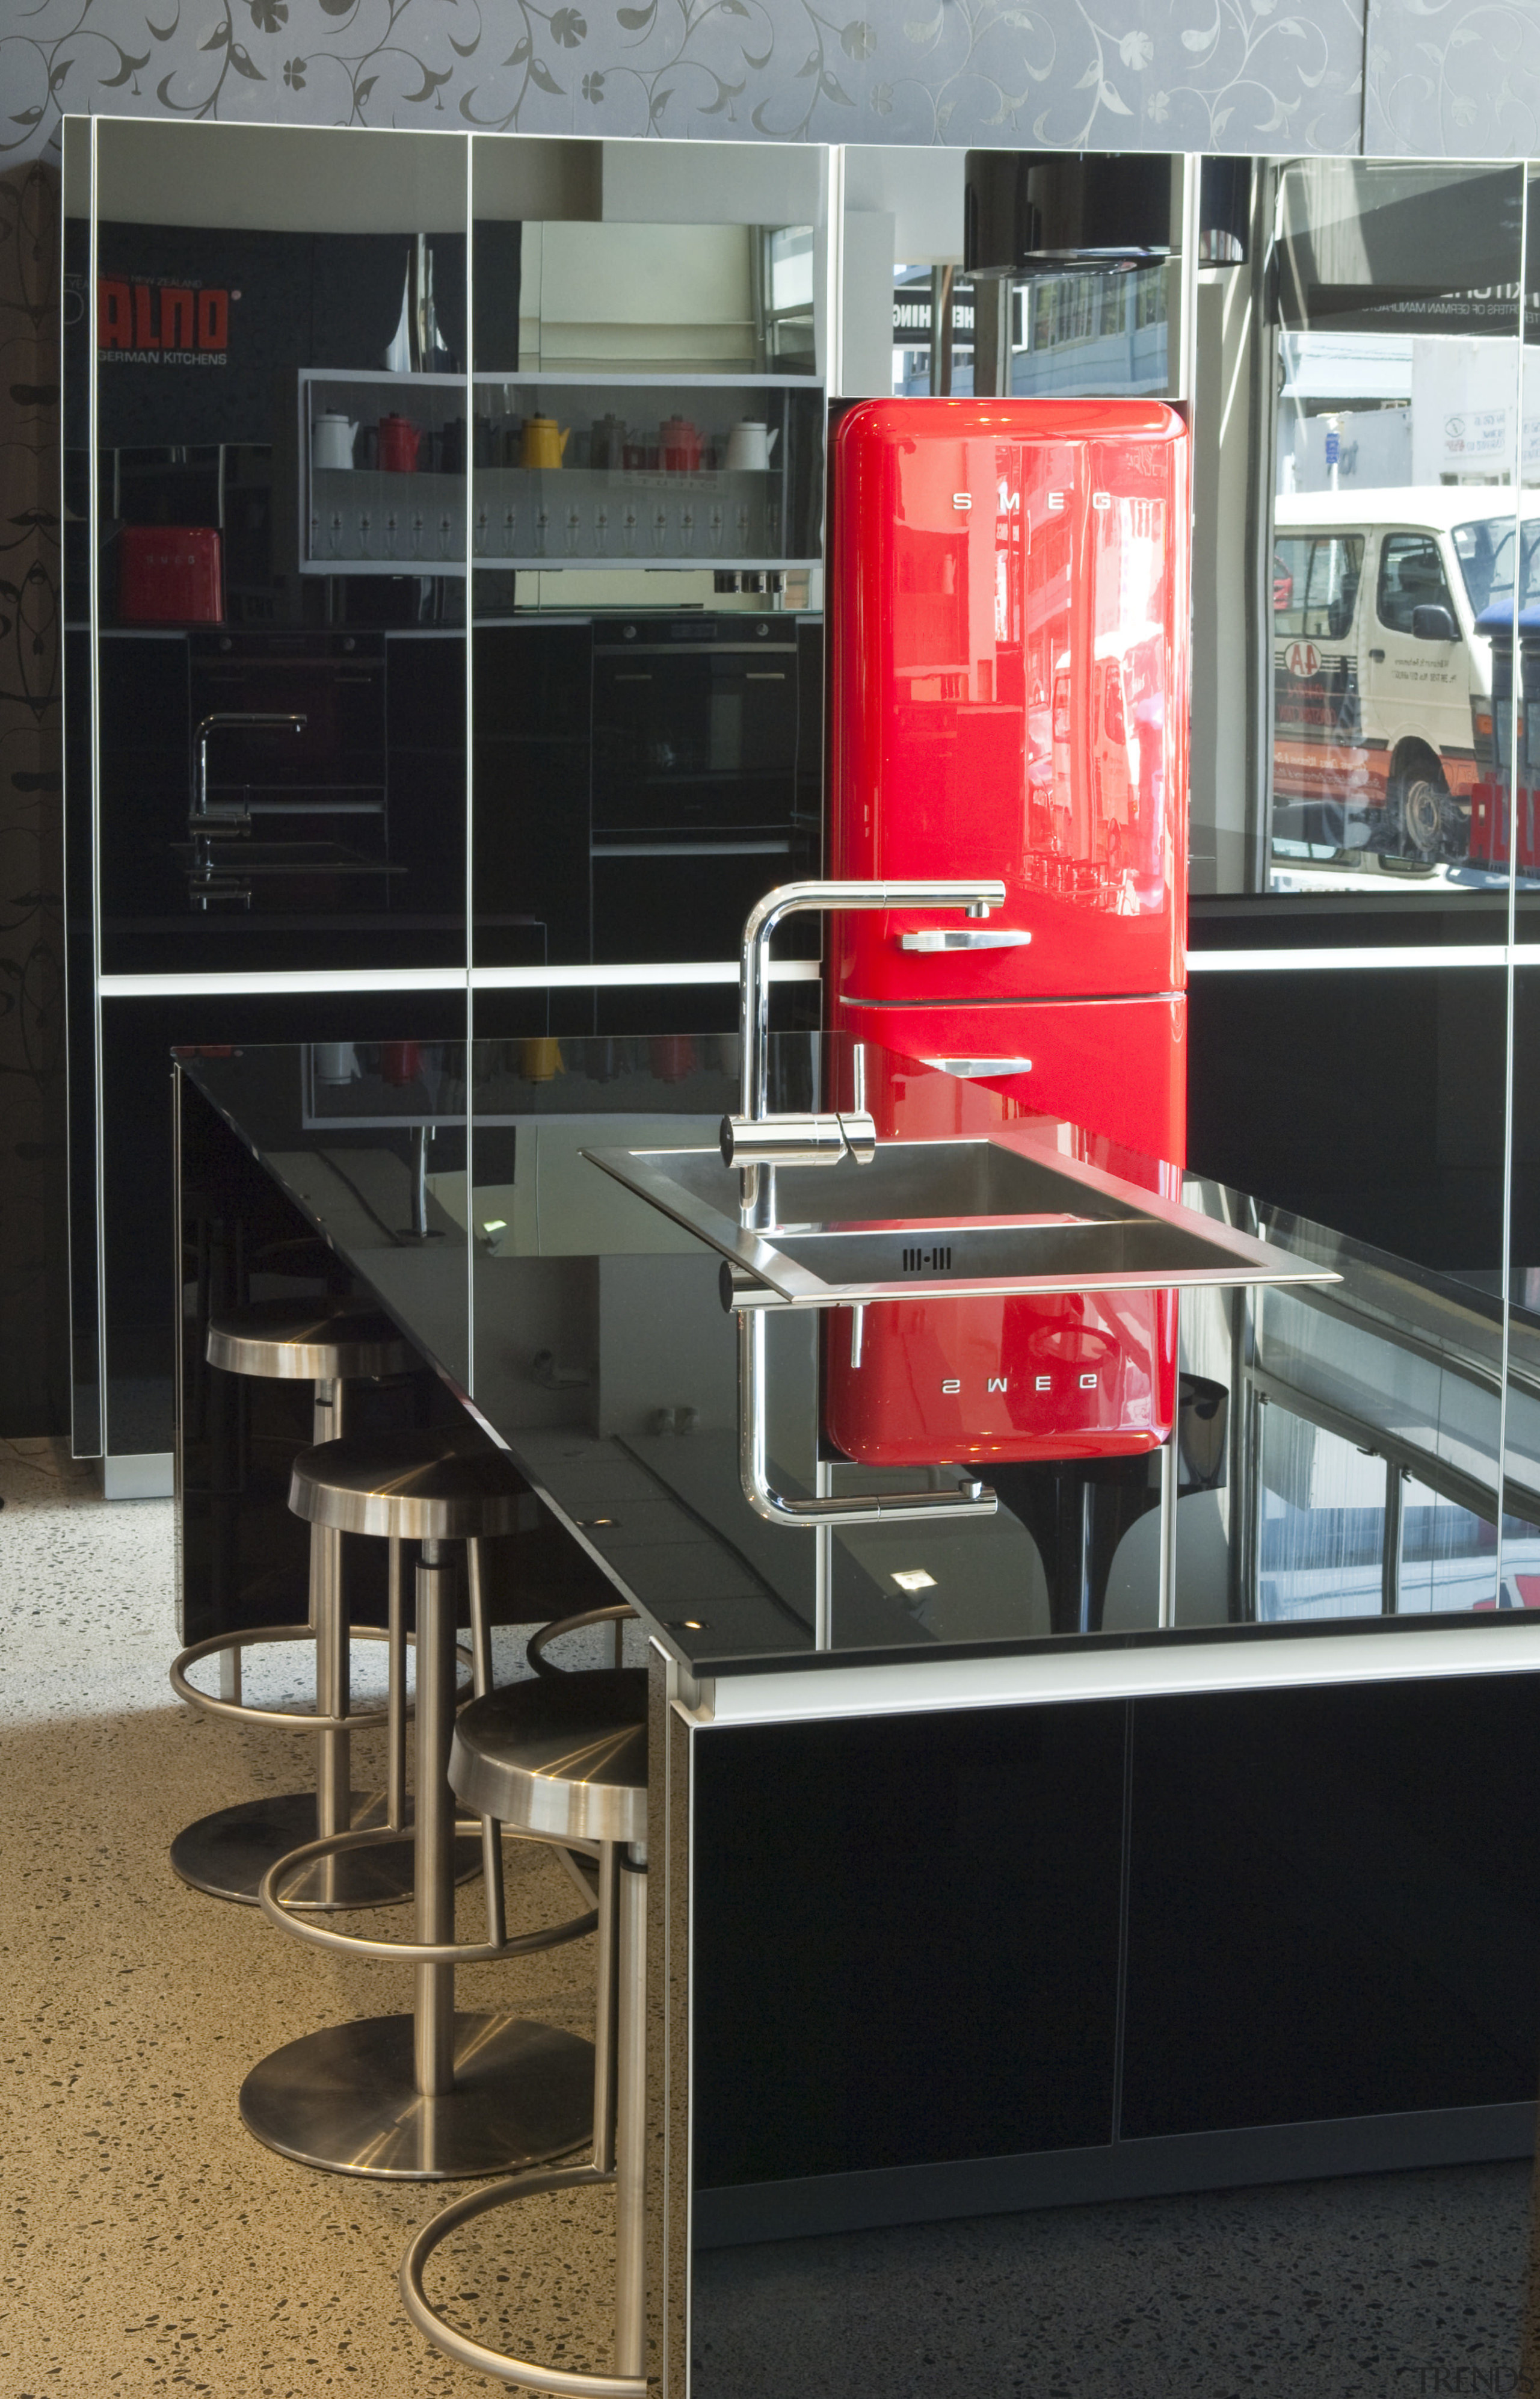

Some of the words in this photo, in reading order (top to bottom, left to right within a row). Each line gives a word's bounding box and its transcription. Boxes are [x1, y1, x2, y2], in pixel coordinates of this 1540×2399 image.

[97, 279, 229, 349] ALNO
[97, 350, 159, 363] GERMAN
[163, 351, 227, 366] KITCHENS
[952, 492, 1112, 510] SMEG
